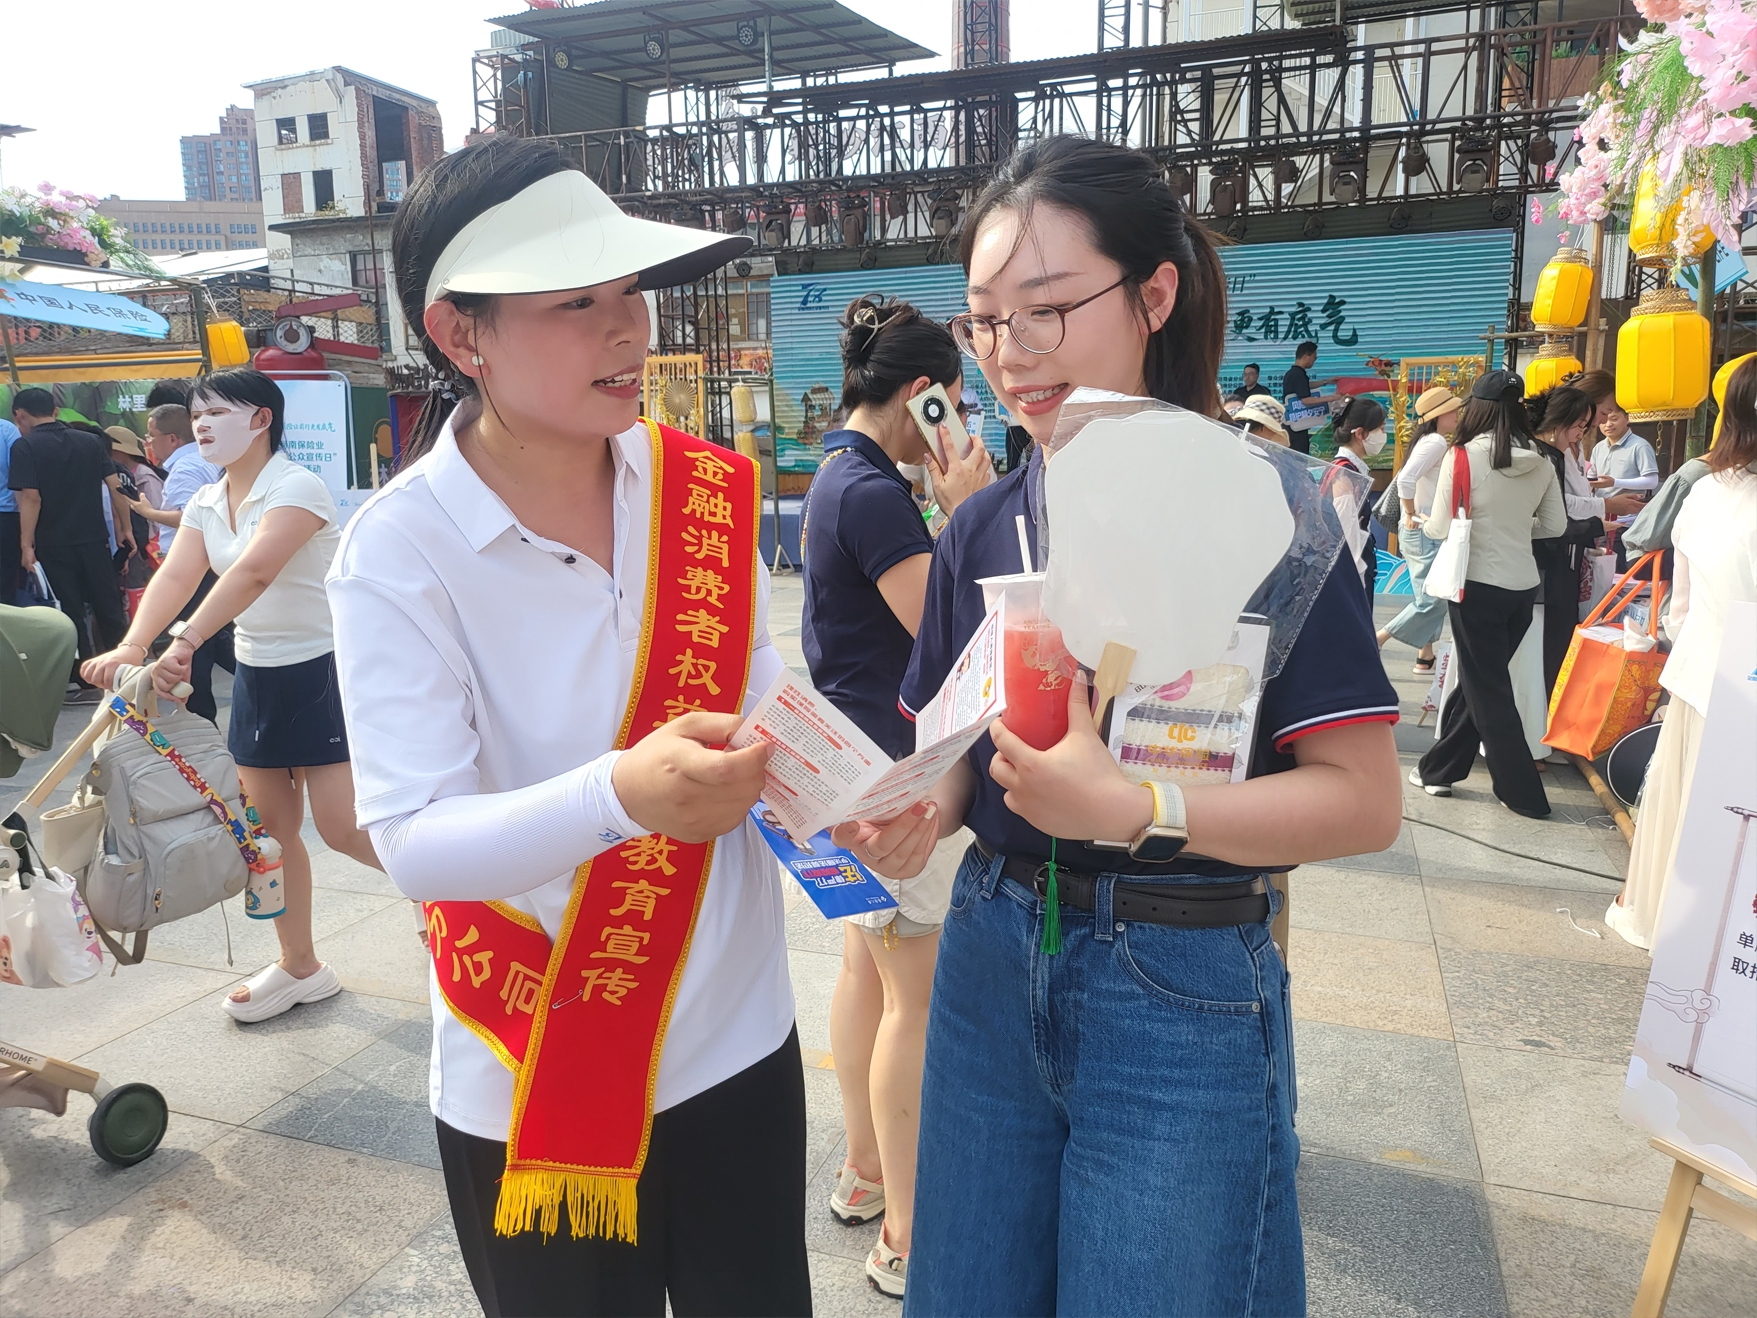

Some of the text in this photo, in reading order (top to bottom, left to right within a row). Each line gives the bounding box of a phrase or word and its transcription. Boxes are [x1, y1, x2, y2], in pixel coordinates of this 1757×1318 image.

[14, 291, 152, 323] 中国人民保险
[1230, 294, 1359, 347] 更有底气
[117, 394, 147, 412] 林里
[581, 834, 678, 1006] 教育宣传
[1737, 931, 1757, 952] 单
